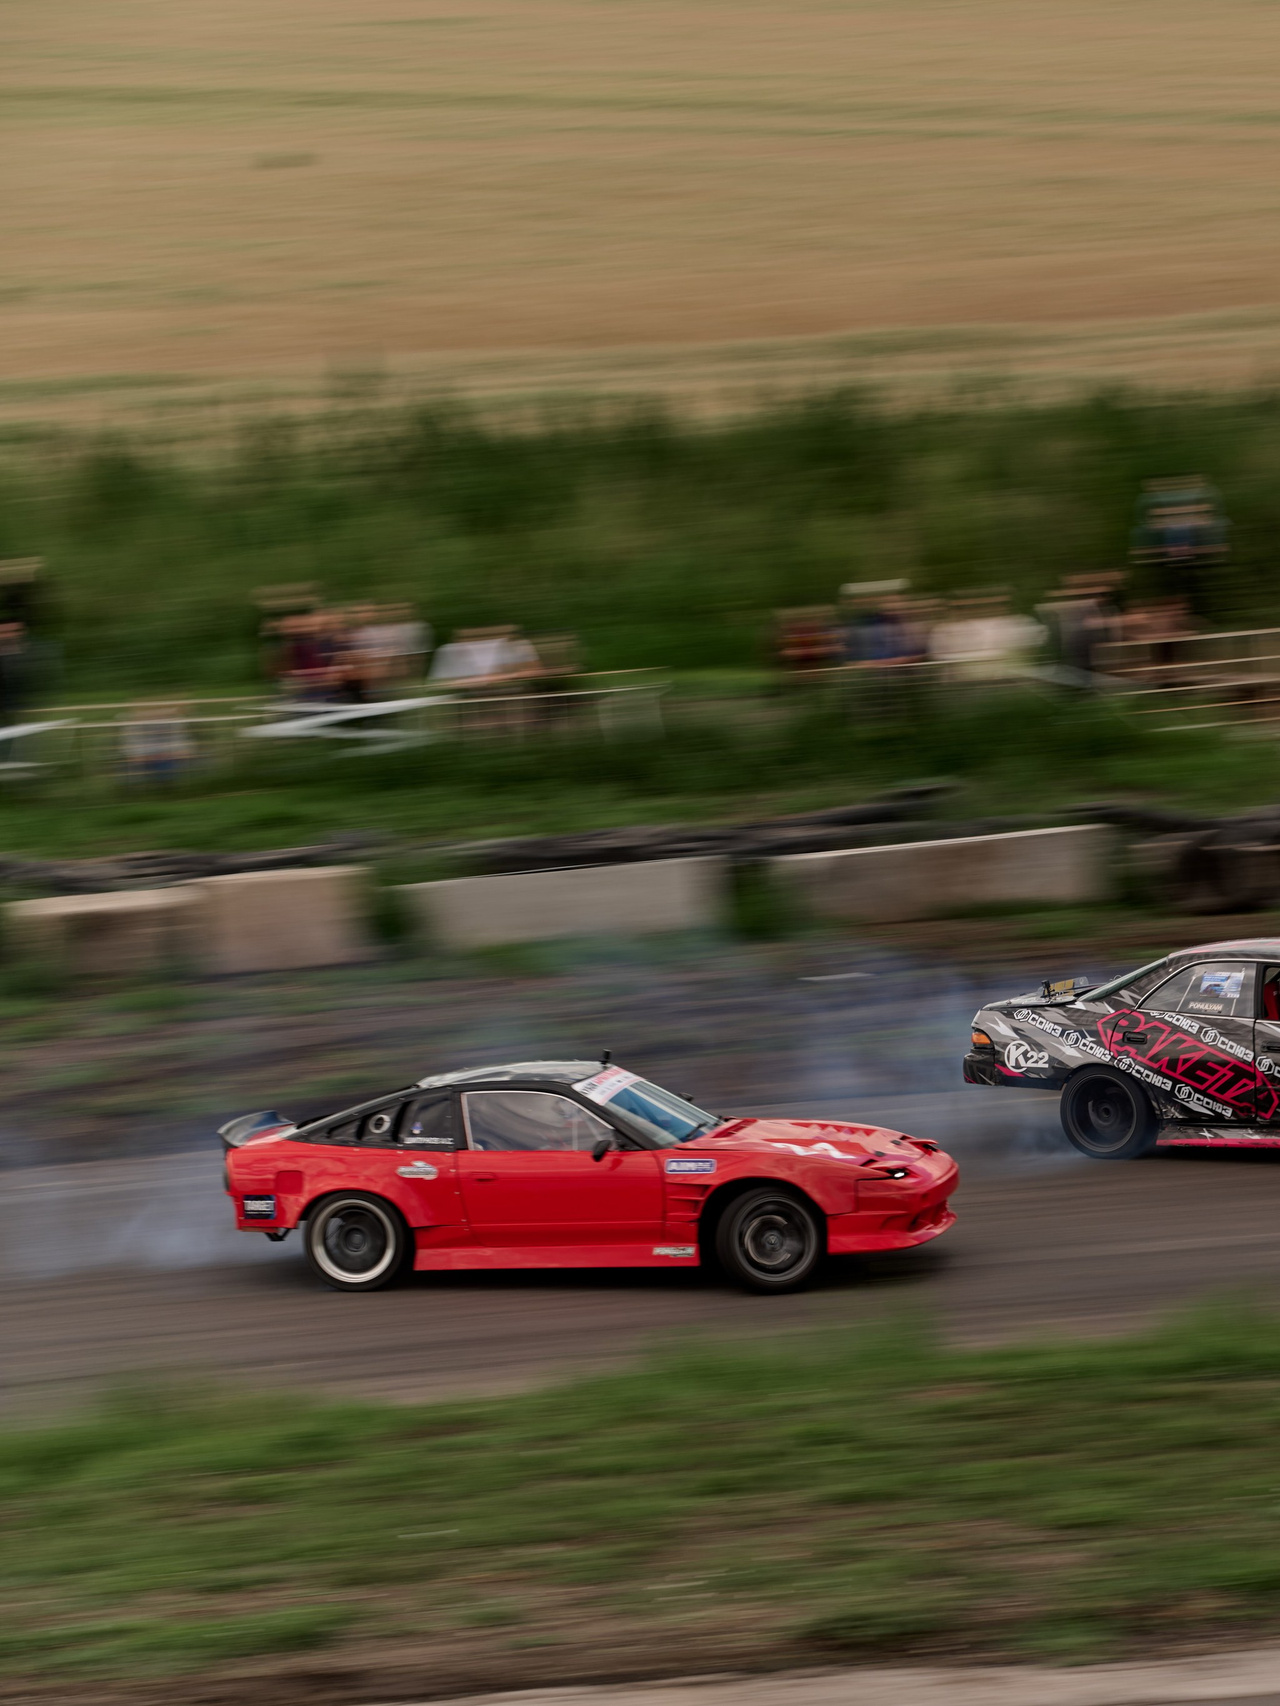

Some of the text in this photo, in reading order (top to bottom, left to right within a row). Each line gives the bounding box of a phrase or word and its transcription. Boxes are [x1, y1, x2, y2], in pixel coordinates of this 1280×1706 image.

[1028, 1013, 1062, 1038] СОЮЗ
[1164, 1012, 1201, 1035] СОЮЗ
[1078, 1038, 1112, 1063] СОЮЗ
[1217, 1036, 1255, 1062] СОЮЗ
[1132, 1065, 1173, 1091] СОЮЗ
[1193, 1095, 1233, 1117] СОЮЗ
